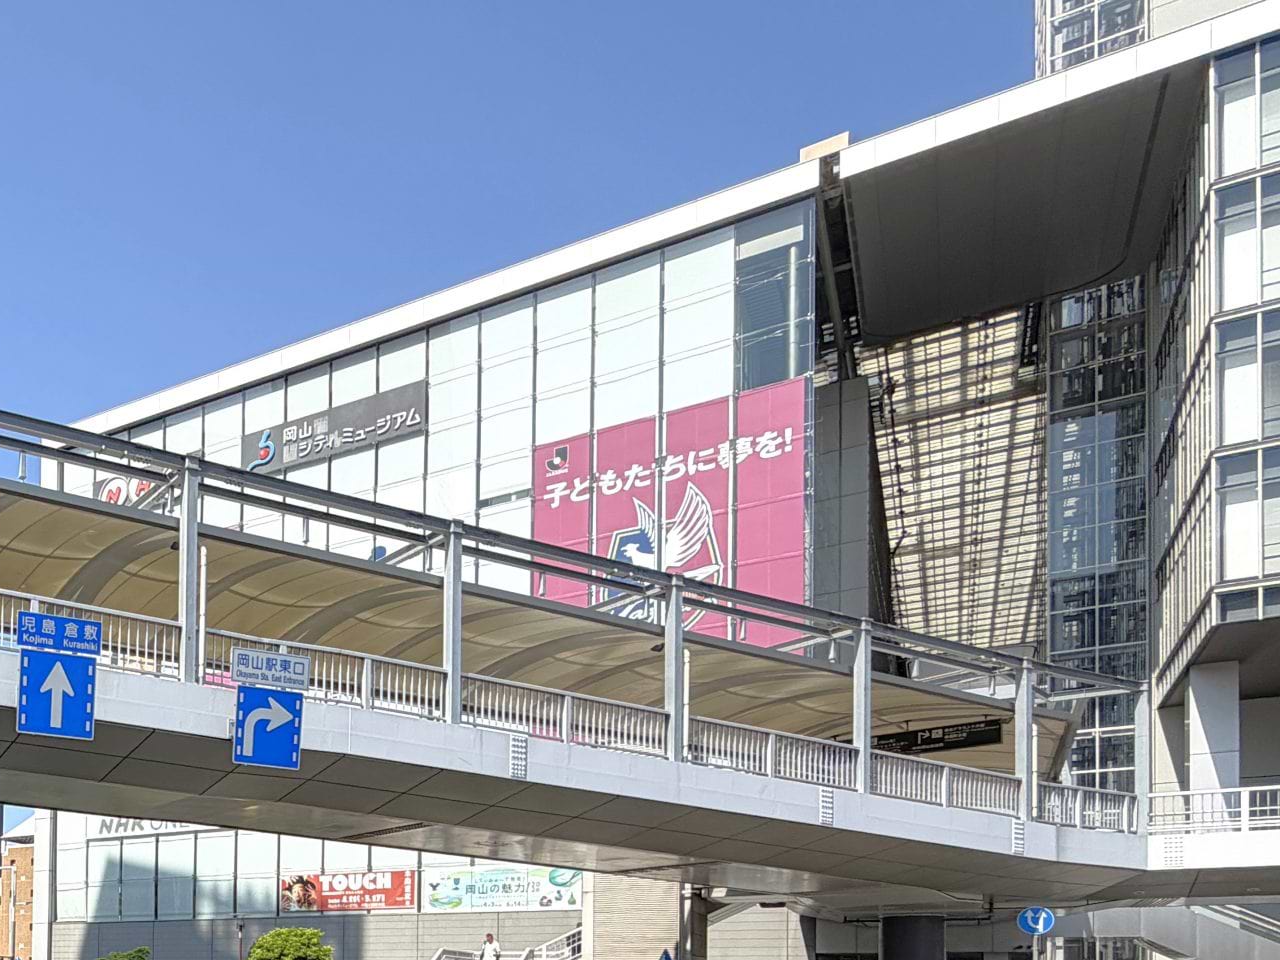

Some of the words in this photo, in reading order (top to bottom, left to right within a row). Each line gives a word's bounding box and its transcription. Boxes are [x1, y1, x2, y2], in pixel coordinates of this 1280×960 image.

[283, 421, 313, 444] 岡山
[298, 408, 422, 457] シティミュージアム
[543, 427, 793, 509] 子どもたちに夢を!
[21, 615, 56, 635] 児島
[64, 622, 98, 641] 倉敷
[22, 632, 54, 646] Kojima
[63, 638, 98, 651] Kurashiki
[237, 653, 305, 676] 岡山駅東口
[319, 872, 392, 892] TOUCH
